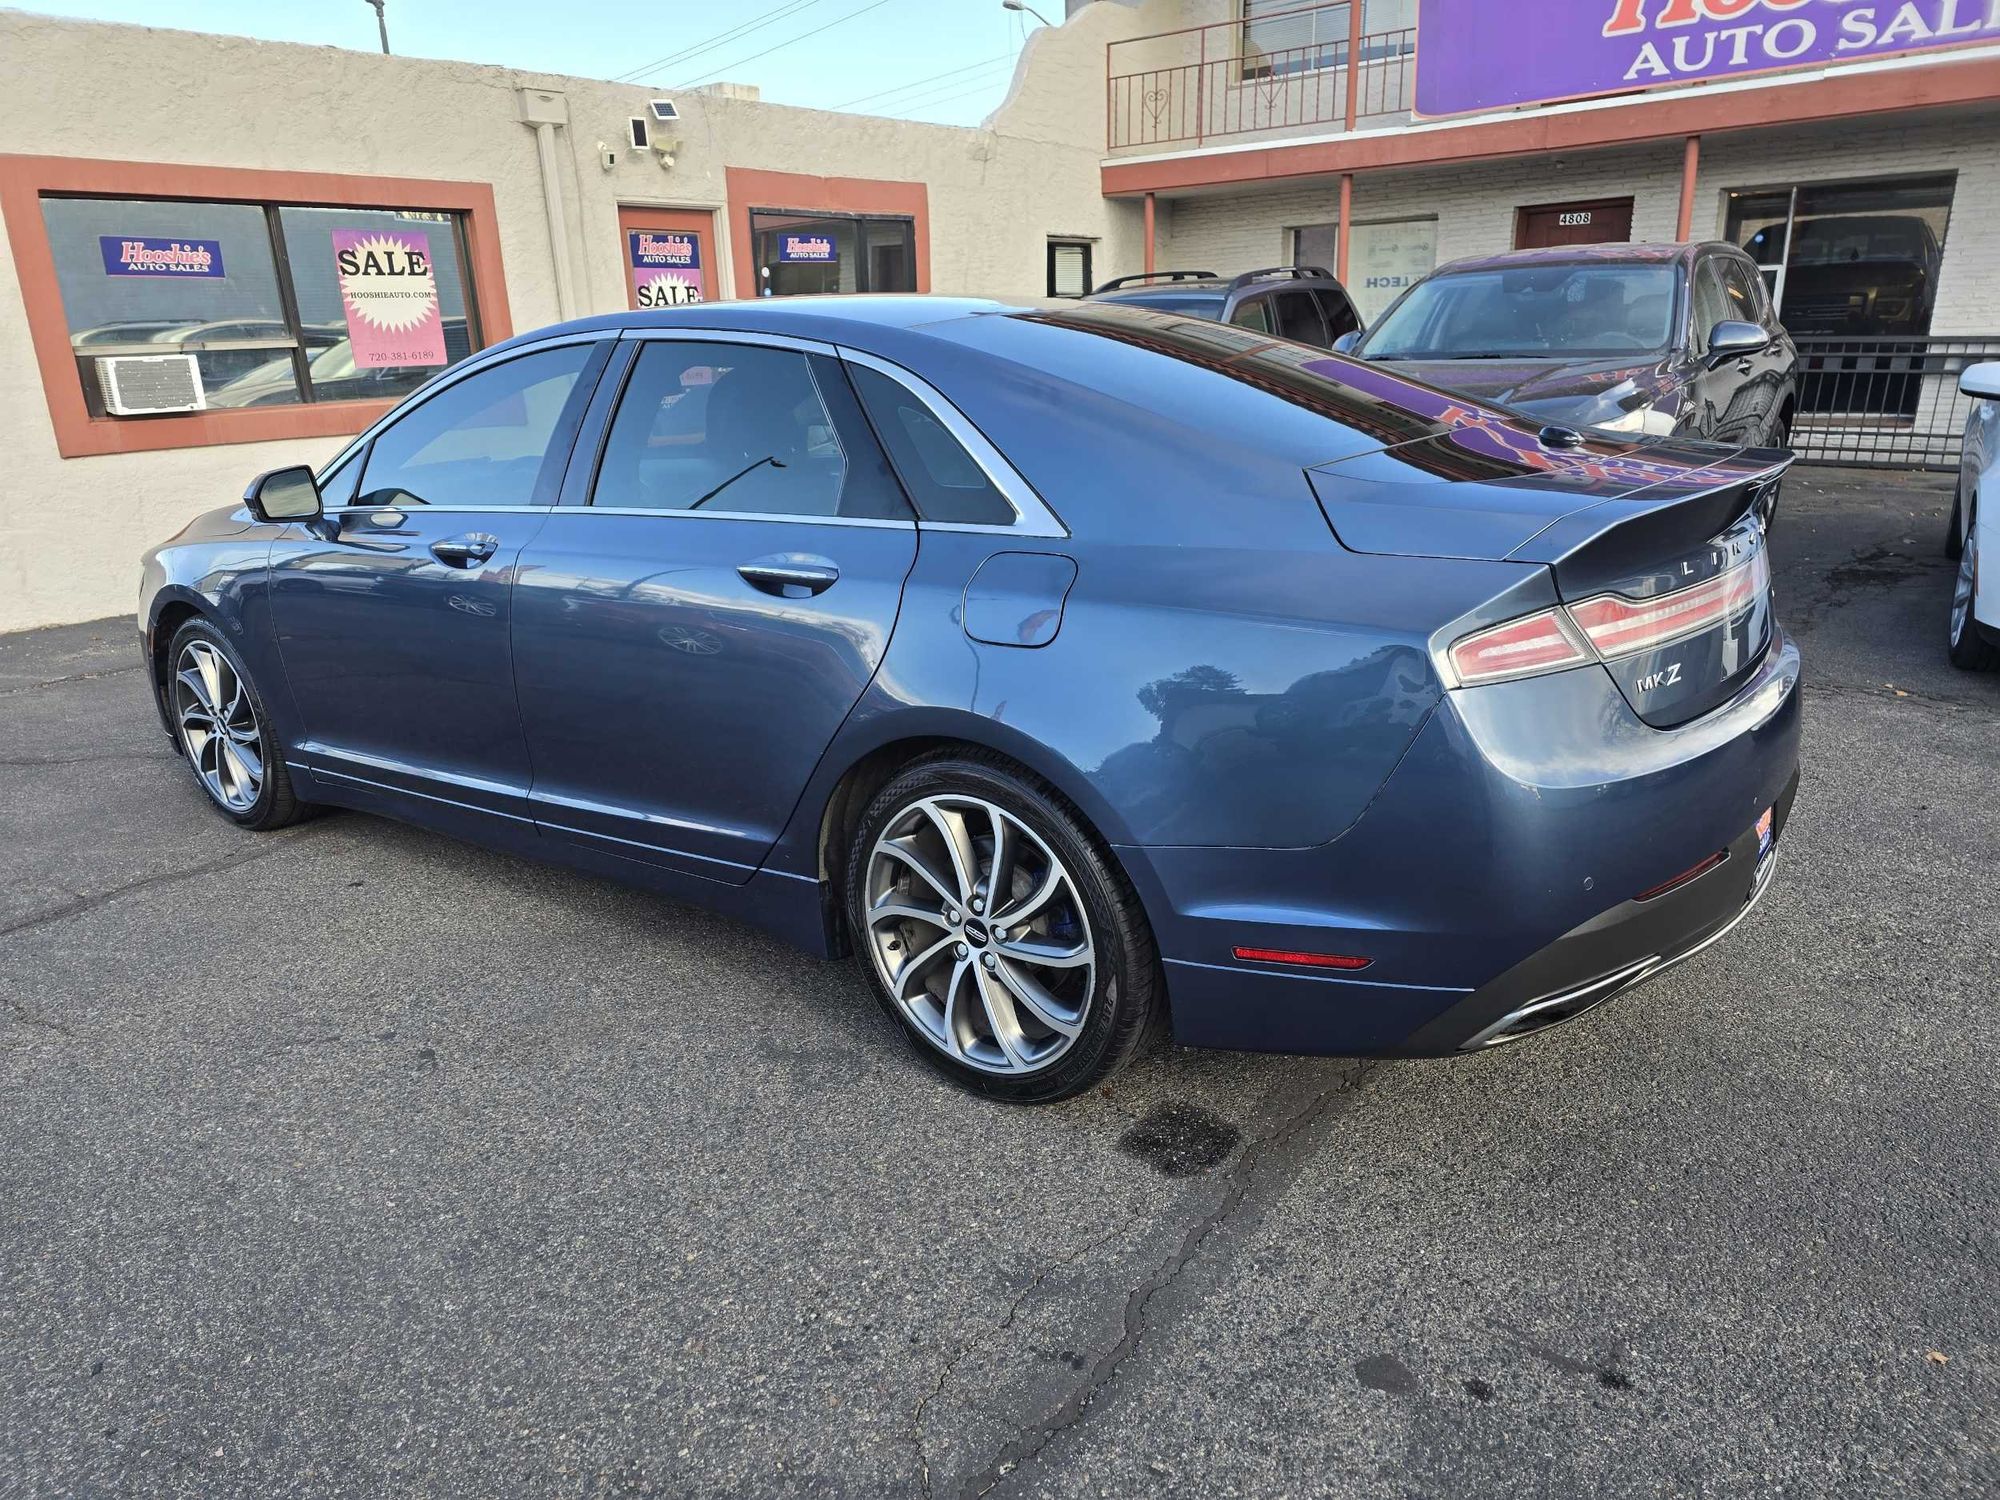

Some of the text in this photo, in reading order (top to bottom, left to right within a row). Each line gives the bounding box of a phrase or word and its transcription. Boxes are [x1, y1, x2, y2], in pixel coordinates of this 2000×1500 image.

[1623, 19, 1816, 80] AUTO
[1560, 213, 1590, 223] 4808
[120, 241, 211, 265] Hooshie's
[638, 234, 692, 256] Hooshie's
[128, 263, 209, 272] AUTO SALES
[338, 249, 428, 276] SALE
[642, 255, 691, 264] AUTO SALES
[350, 290, 432, 299] HOOSHIEAUTO.COM
[637, 285, 701, 307] SALE
[368, 351, 435, 362] 720-381-6189
